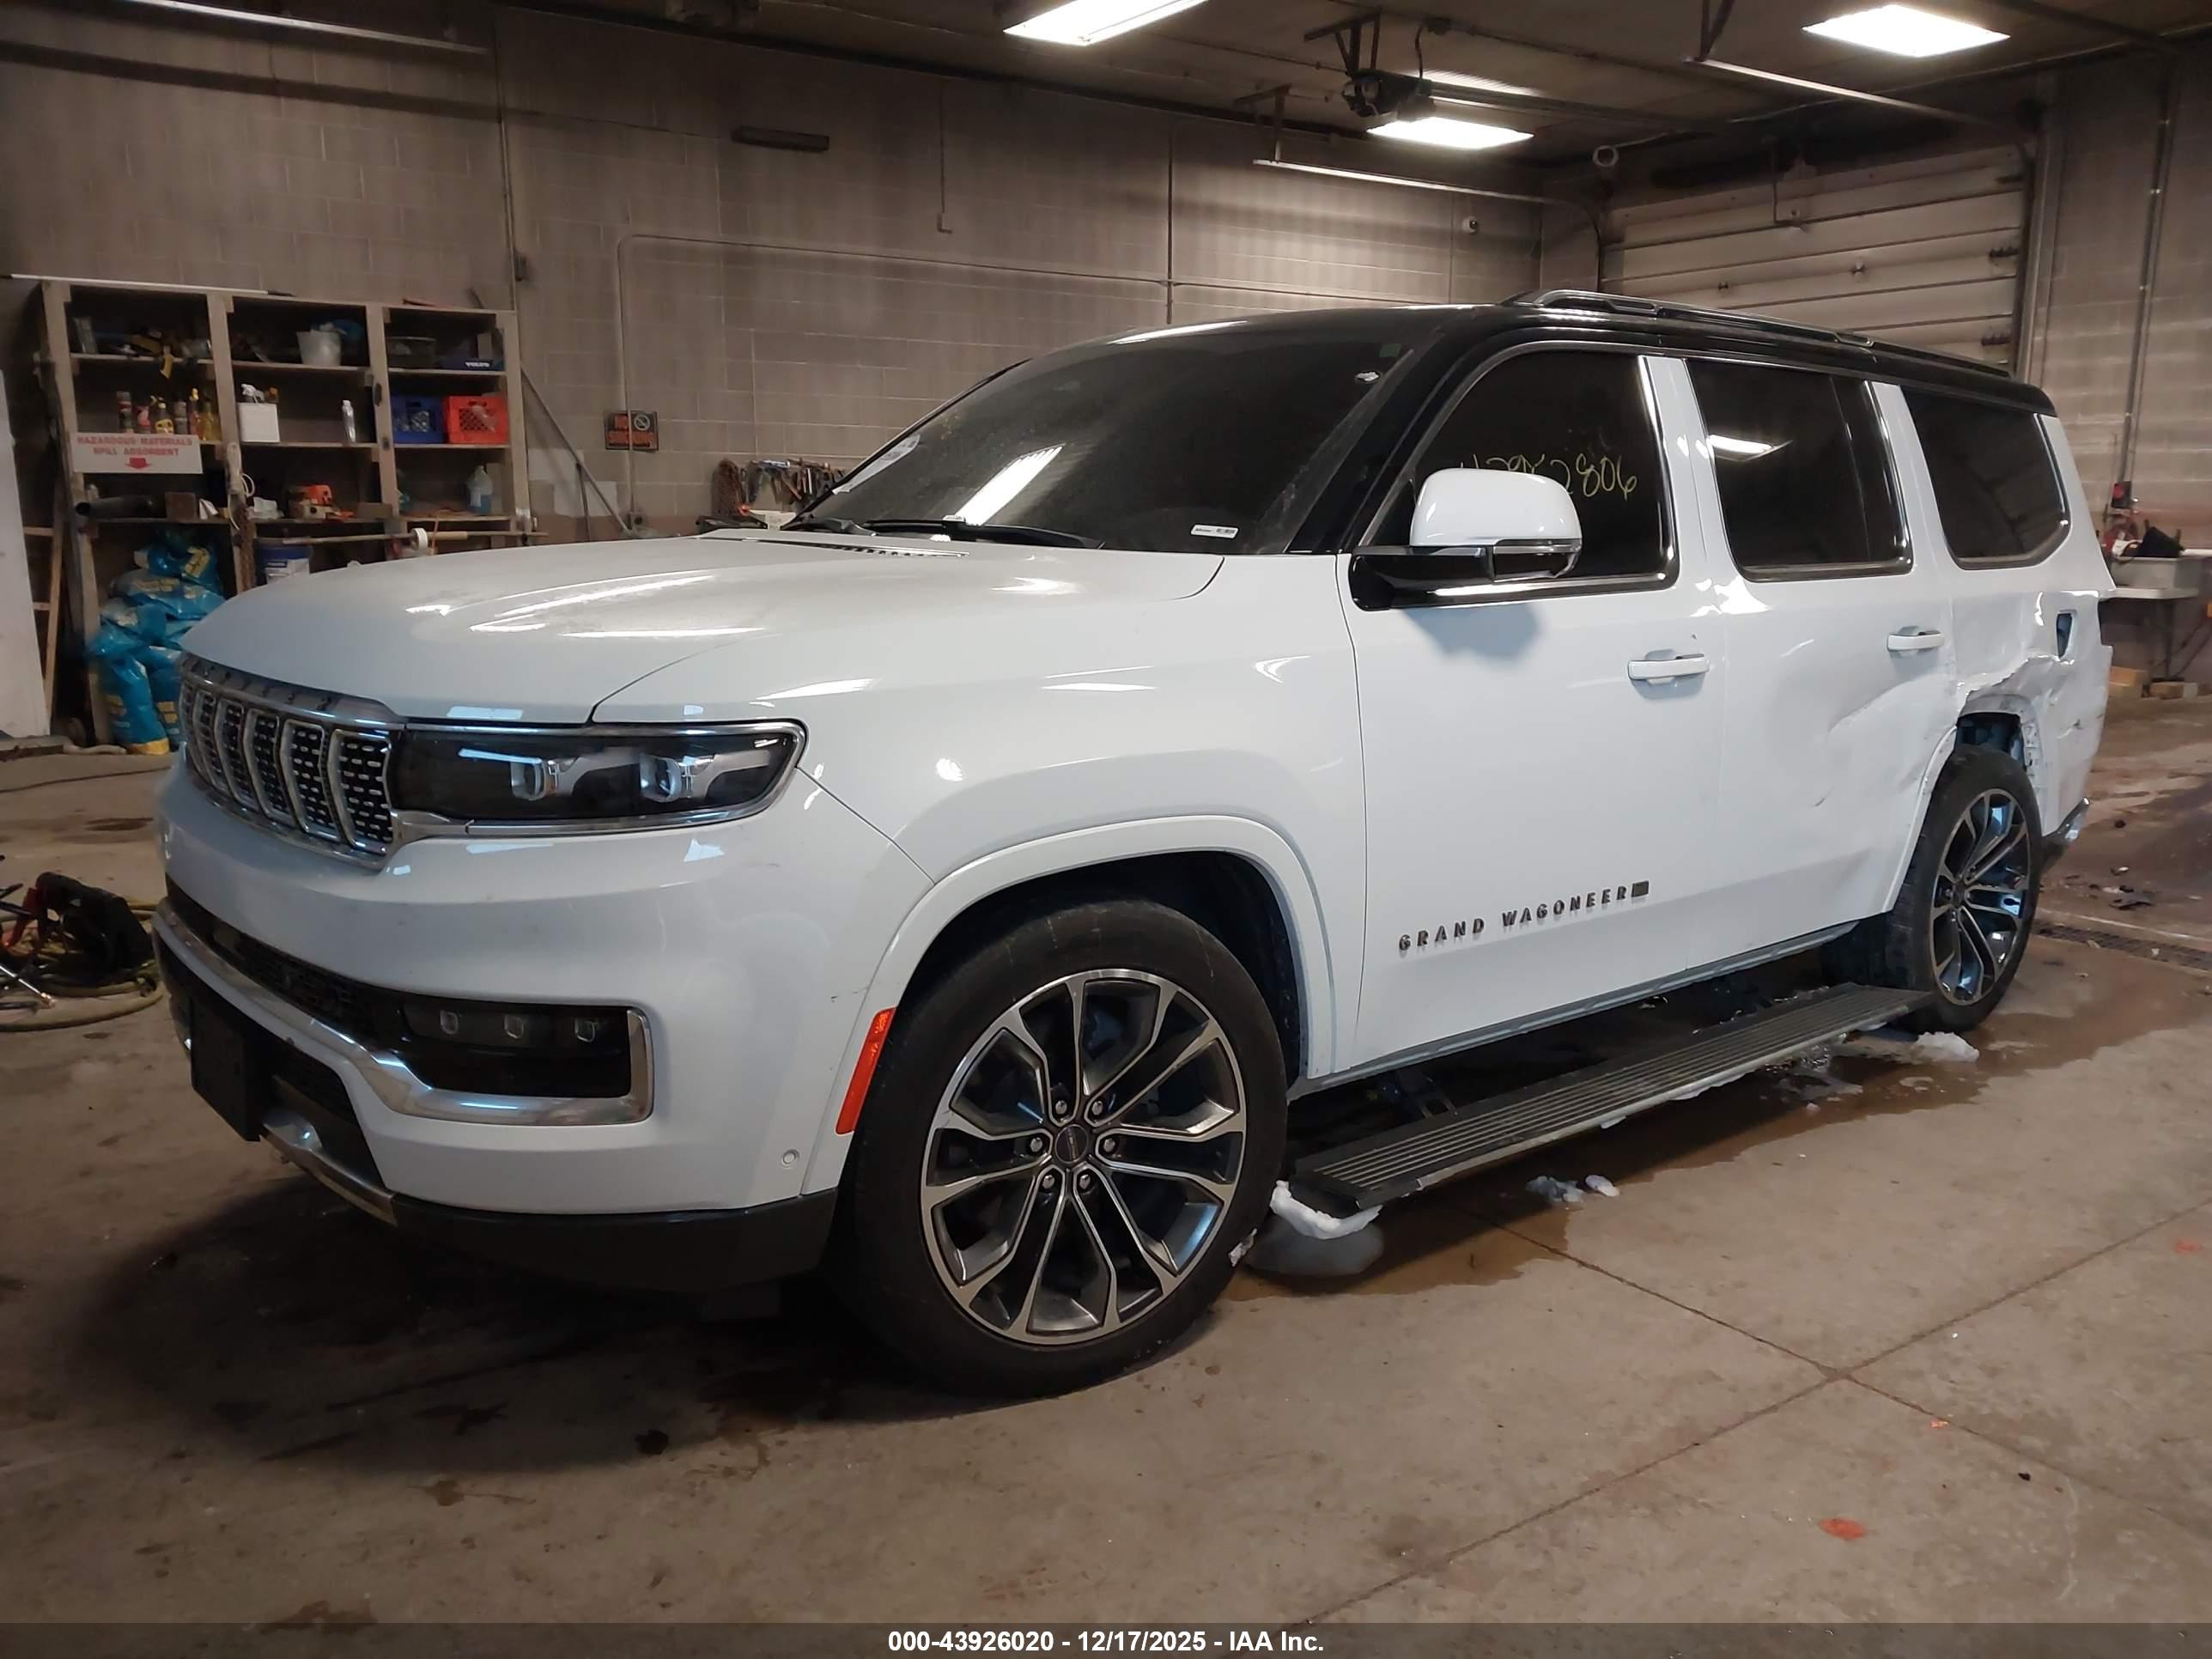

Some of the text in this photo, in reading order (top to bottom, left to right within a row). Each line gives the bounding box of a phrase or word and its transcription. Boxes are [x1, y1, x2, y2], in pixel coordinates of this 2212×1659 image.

[77, 436, 192, 446] HAZARDOUS MATERIALS
[1399, 885, 1627, 951] GRAND WAGONEER
